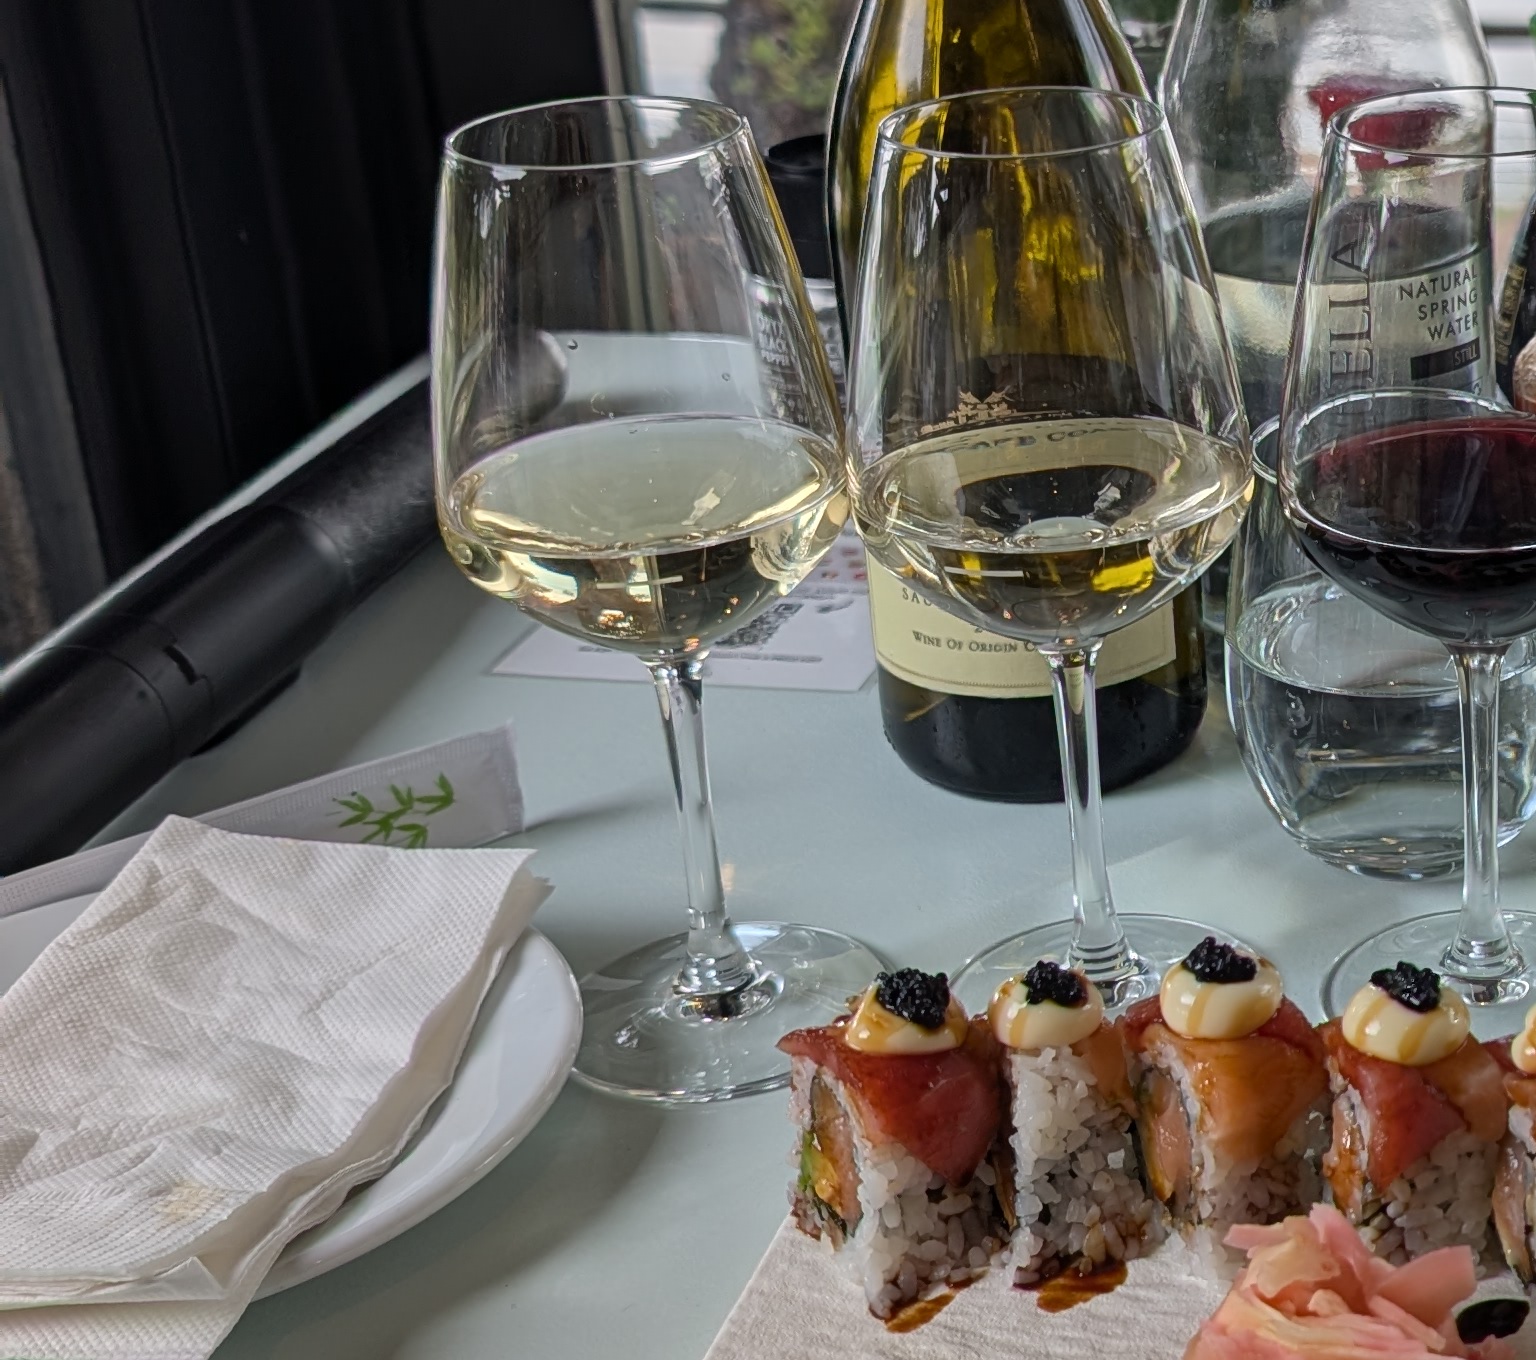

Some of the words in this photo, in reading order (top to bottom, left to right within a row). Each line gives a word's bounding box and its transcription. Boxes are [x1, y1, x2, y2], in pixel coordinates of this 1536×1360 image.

[1398, 264, 1478, 301] NATURAL
[1417, 288, 1478, 321] SPRING
[1427, 312, 1479, 341] WATER
[1453, 345, 1478, 367] STILL
[911, 630, 942, 648] WINE
[968, 640, 1018, 653] ORIGIN
